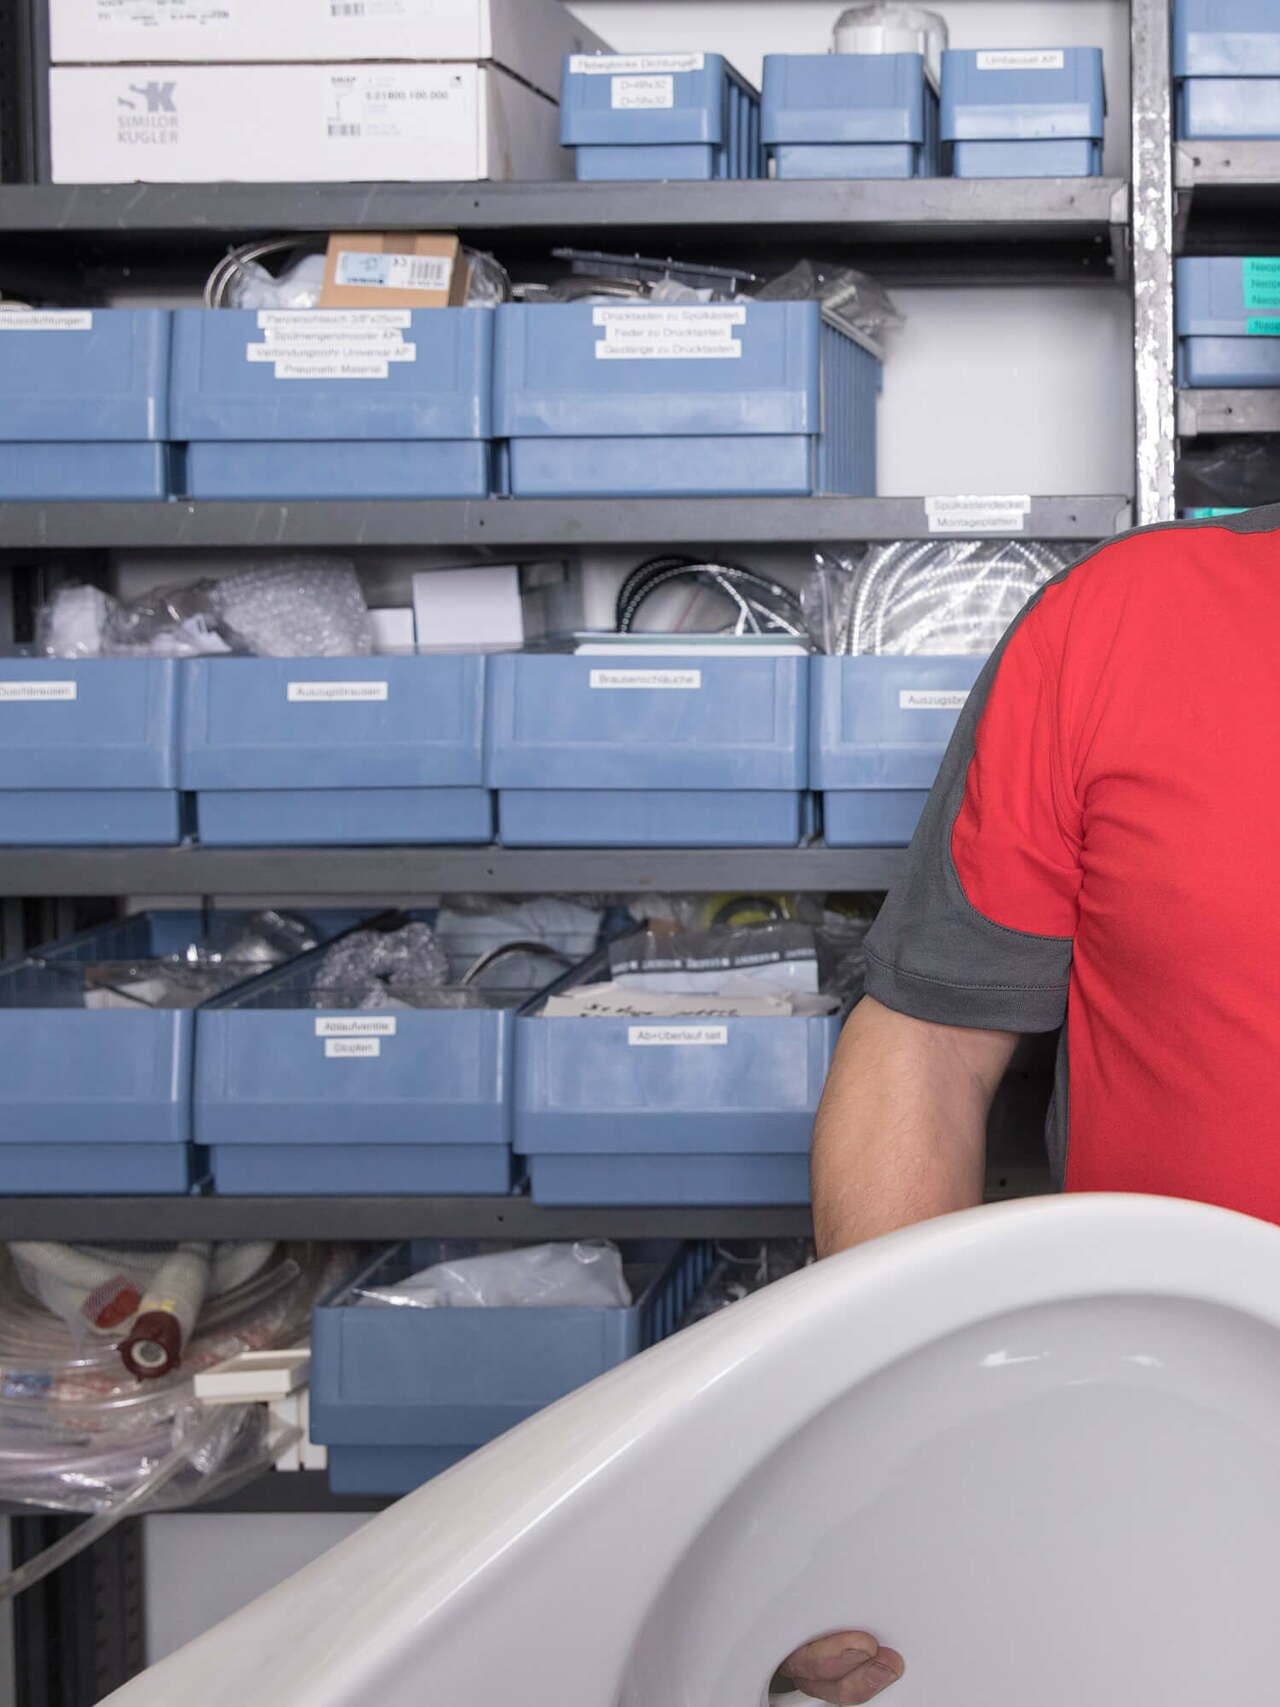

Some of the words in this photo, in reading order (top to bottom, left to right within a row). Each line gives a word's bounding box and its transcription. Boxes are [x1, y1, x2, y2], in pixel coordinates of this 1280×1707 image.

[117, 115, 178, 129] SIMILOR
[117, 130, 178, 145] KUGLER
[936, 516, 1018, 530] Montageplatten
